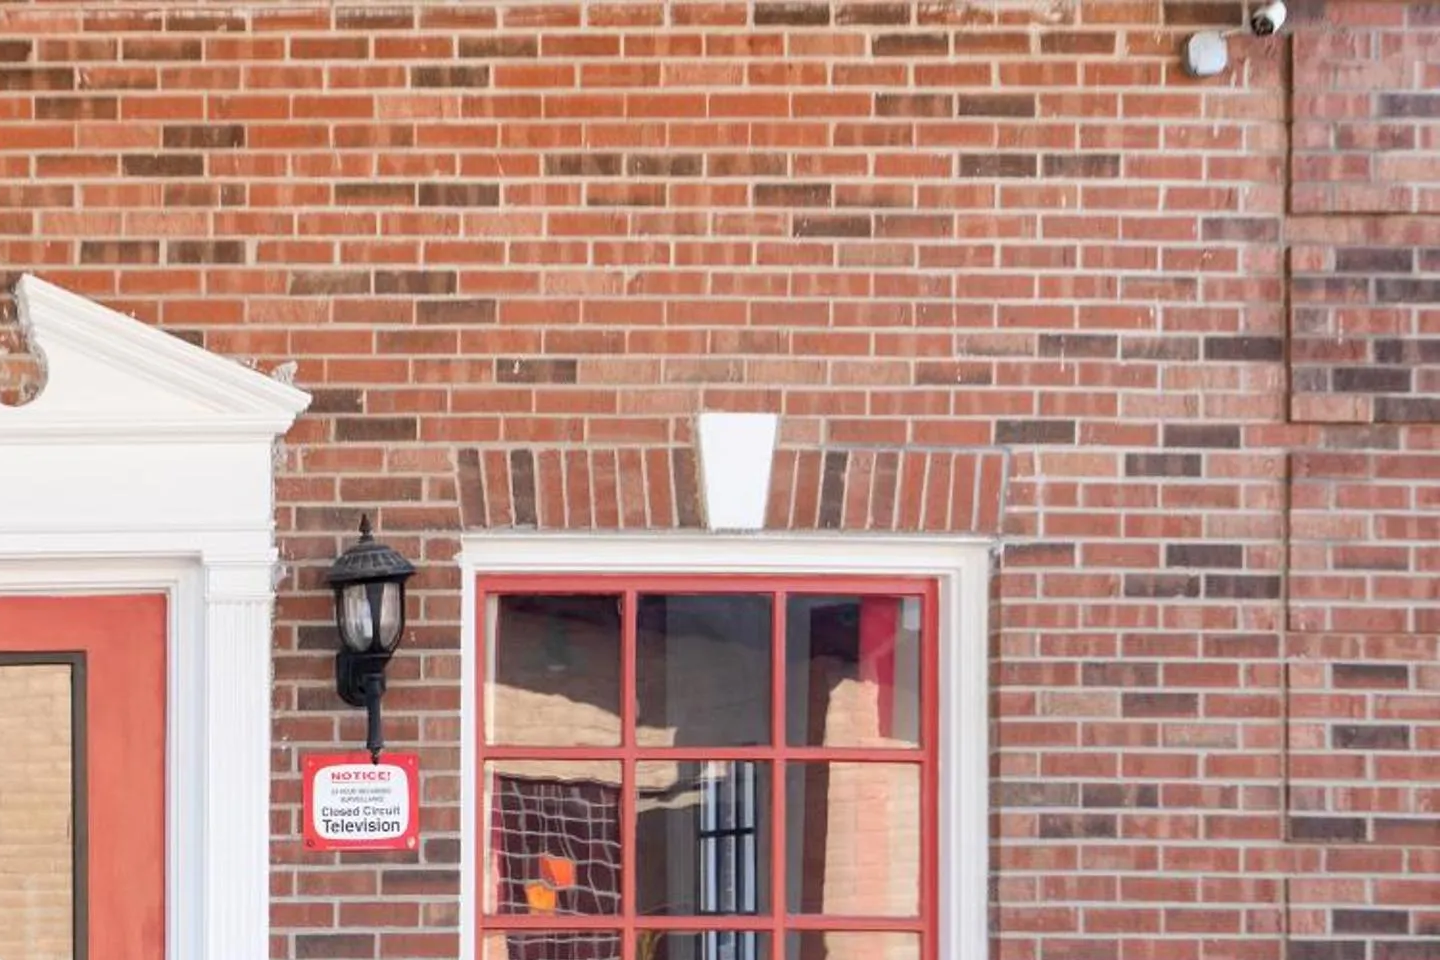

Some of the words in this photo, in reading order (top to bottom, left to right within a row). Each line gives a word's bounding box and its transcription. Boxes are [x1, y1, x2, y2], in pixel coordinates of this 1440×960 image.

[331, 771, 391, 781] NOTICE!
[322, 806, 360, 817] Closed
[363, 805, 401, 816] Circuit
[322, 818, 401, 833] Television
